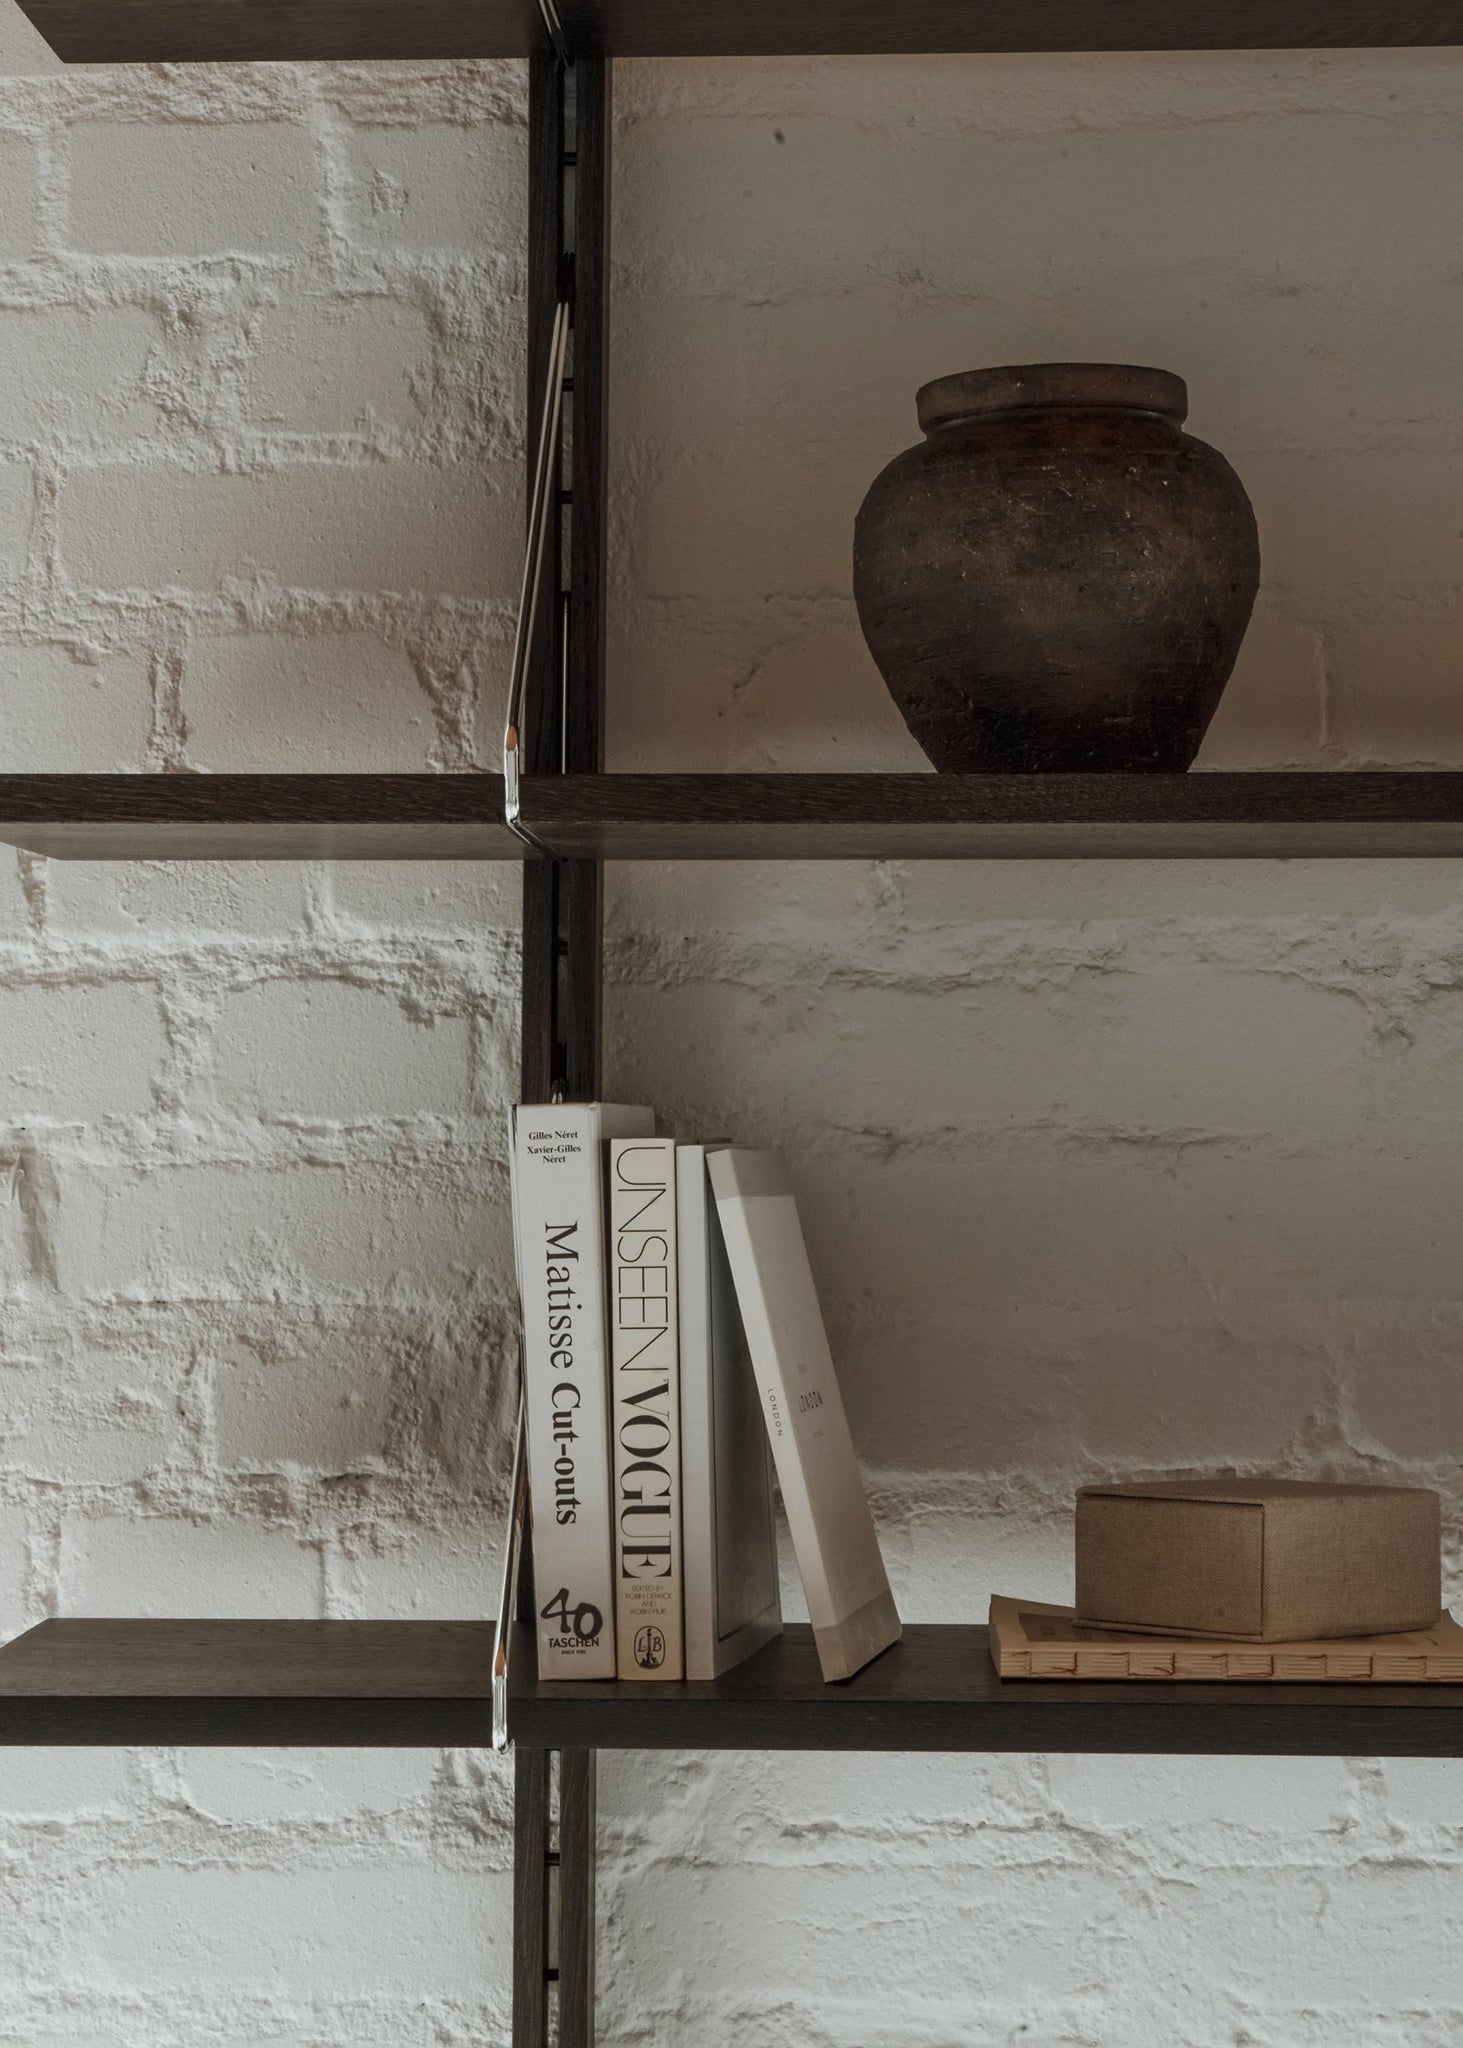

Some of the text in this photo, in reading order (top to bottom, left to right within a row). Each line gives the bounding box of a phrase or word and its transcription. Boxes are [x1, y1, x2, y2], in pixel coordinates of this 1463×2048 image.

[527, 1144, 581, 1154] Xavier-Gilles
[528, 1130, 578, 1140] Gilles Néret
[543, 1155, 566, 1164] Néret
[545, 1221, 582, 1525] Matisse Cut-outs
[616, 1147, 672, 1578] UNSEEN VOGUE
[768, 1388, 783, 1436] LONDON
[540, 1587, 603, 1639] 40
[548, 1637, 599, 1648] TASCHEN
